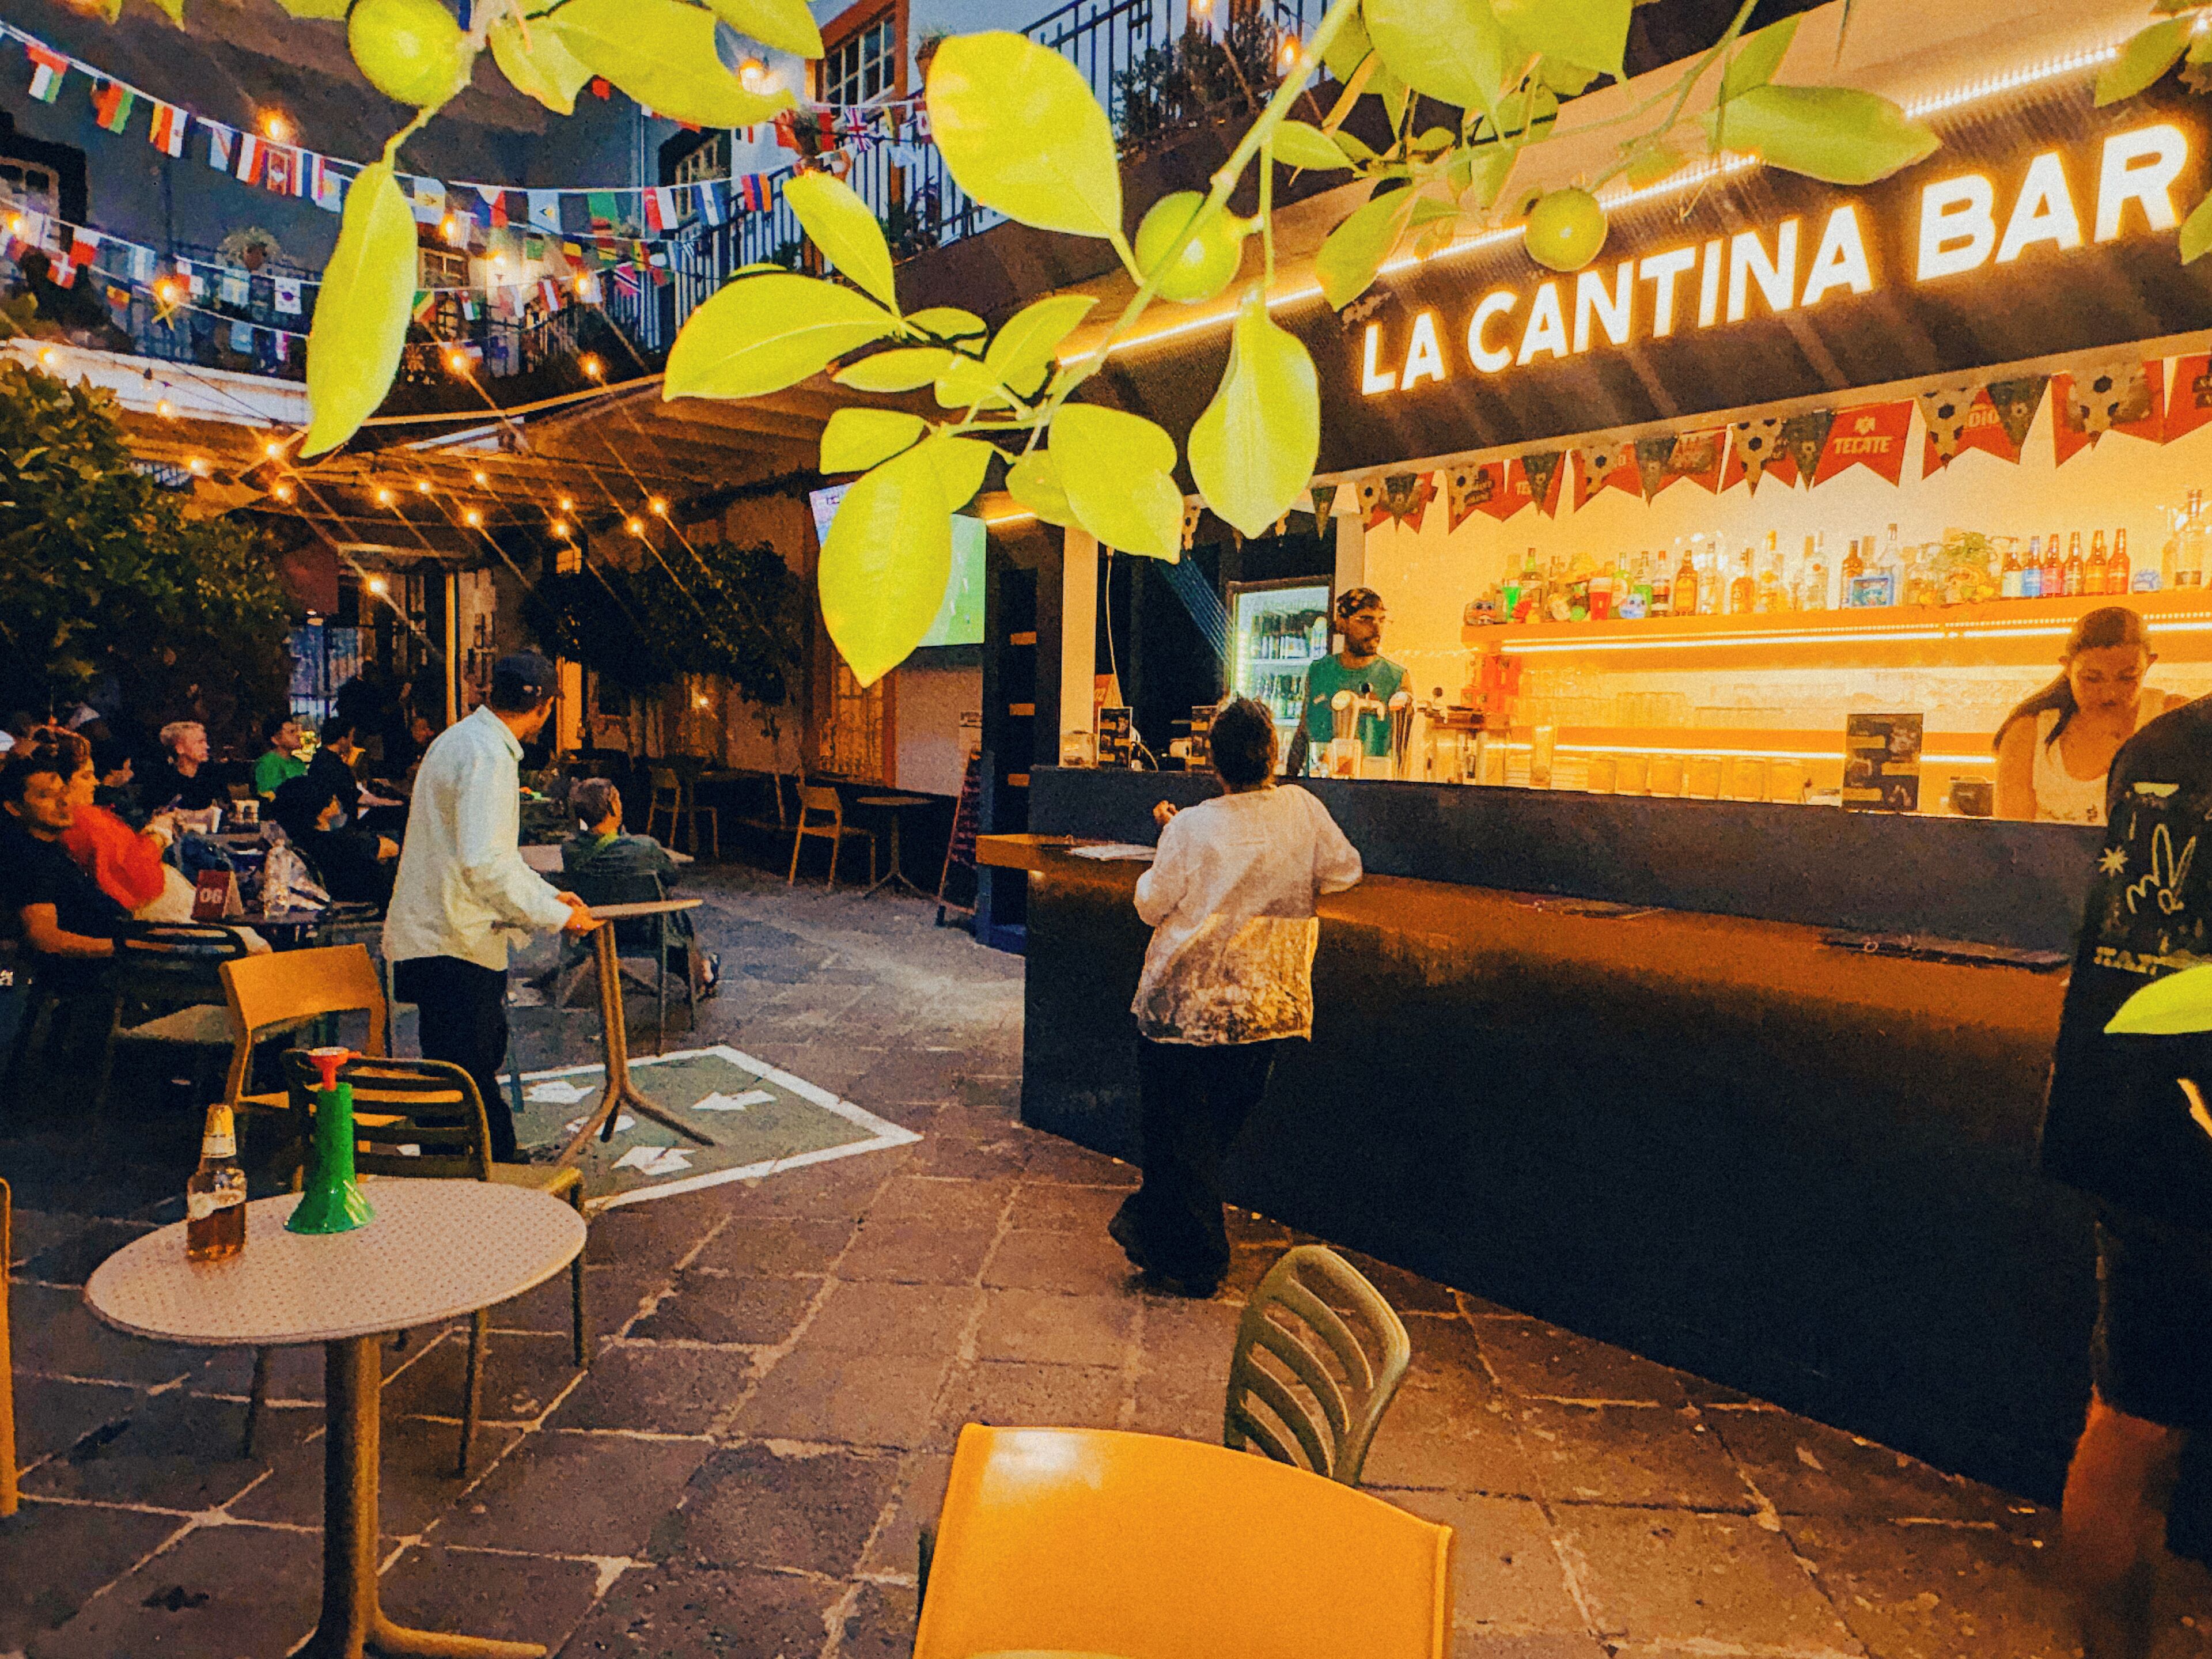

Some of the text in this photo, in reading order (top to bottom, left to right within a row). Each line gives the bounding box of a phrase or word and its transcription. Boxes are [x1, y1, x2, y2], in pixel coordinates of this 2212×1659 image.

[1361, 123, 2189, 396] LA CANTINA BAR
[1832, 435, 1893, 454] TECATE
